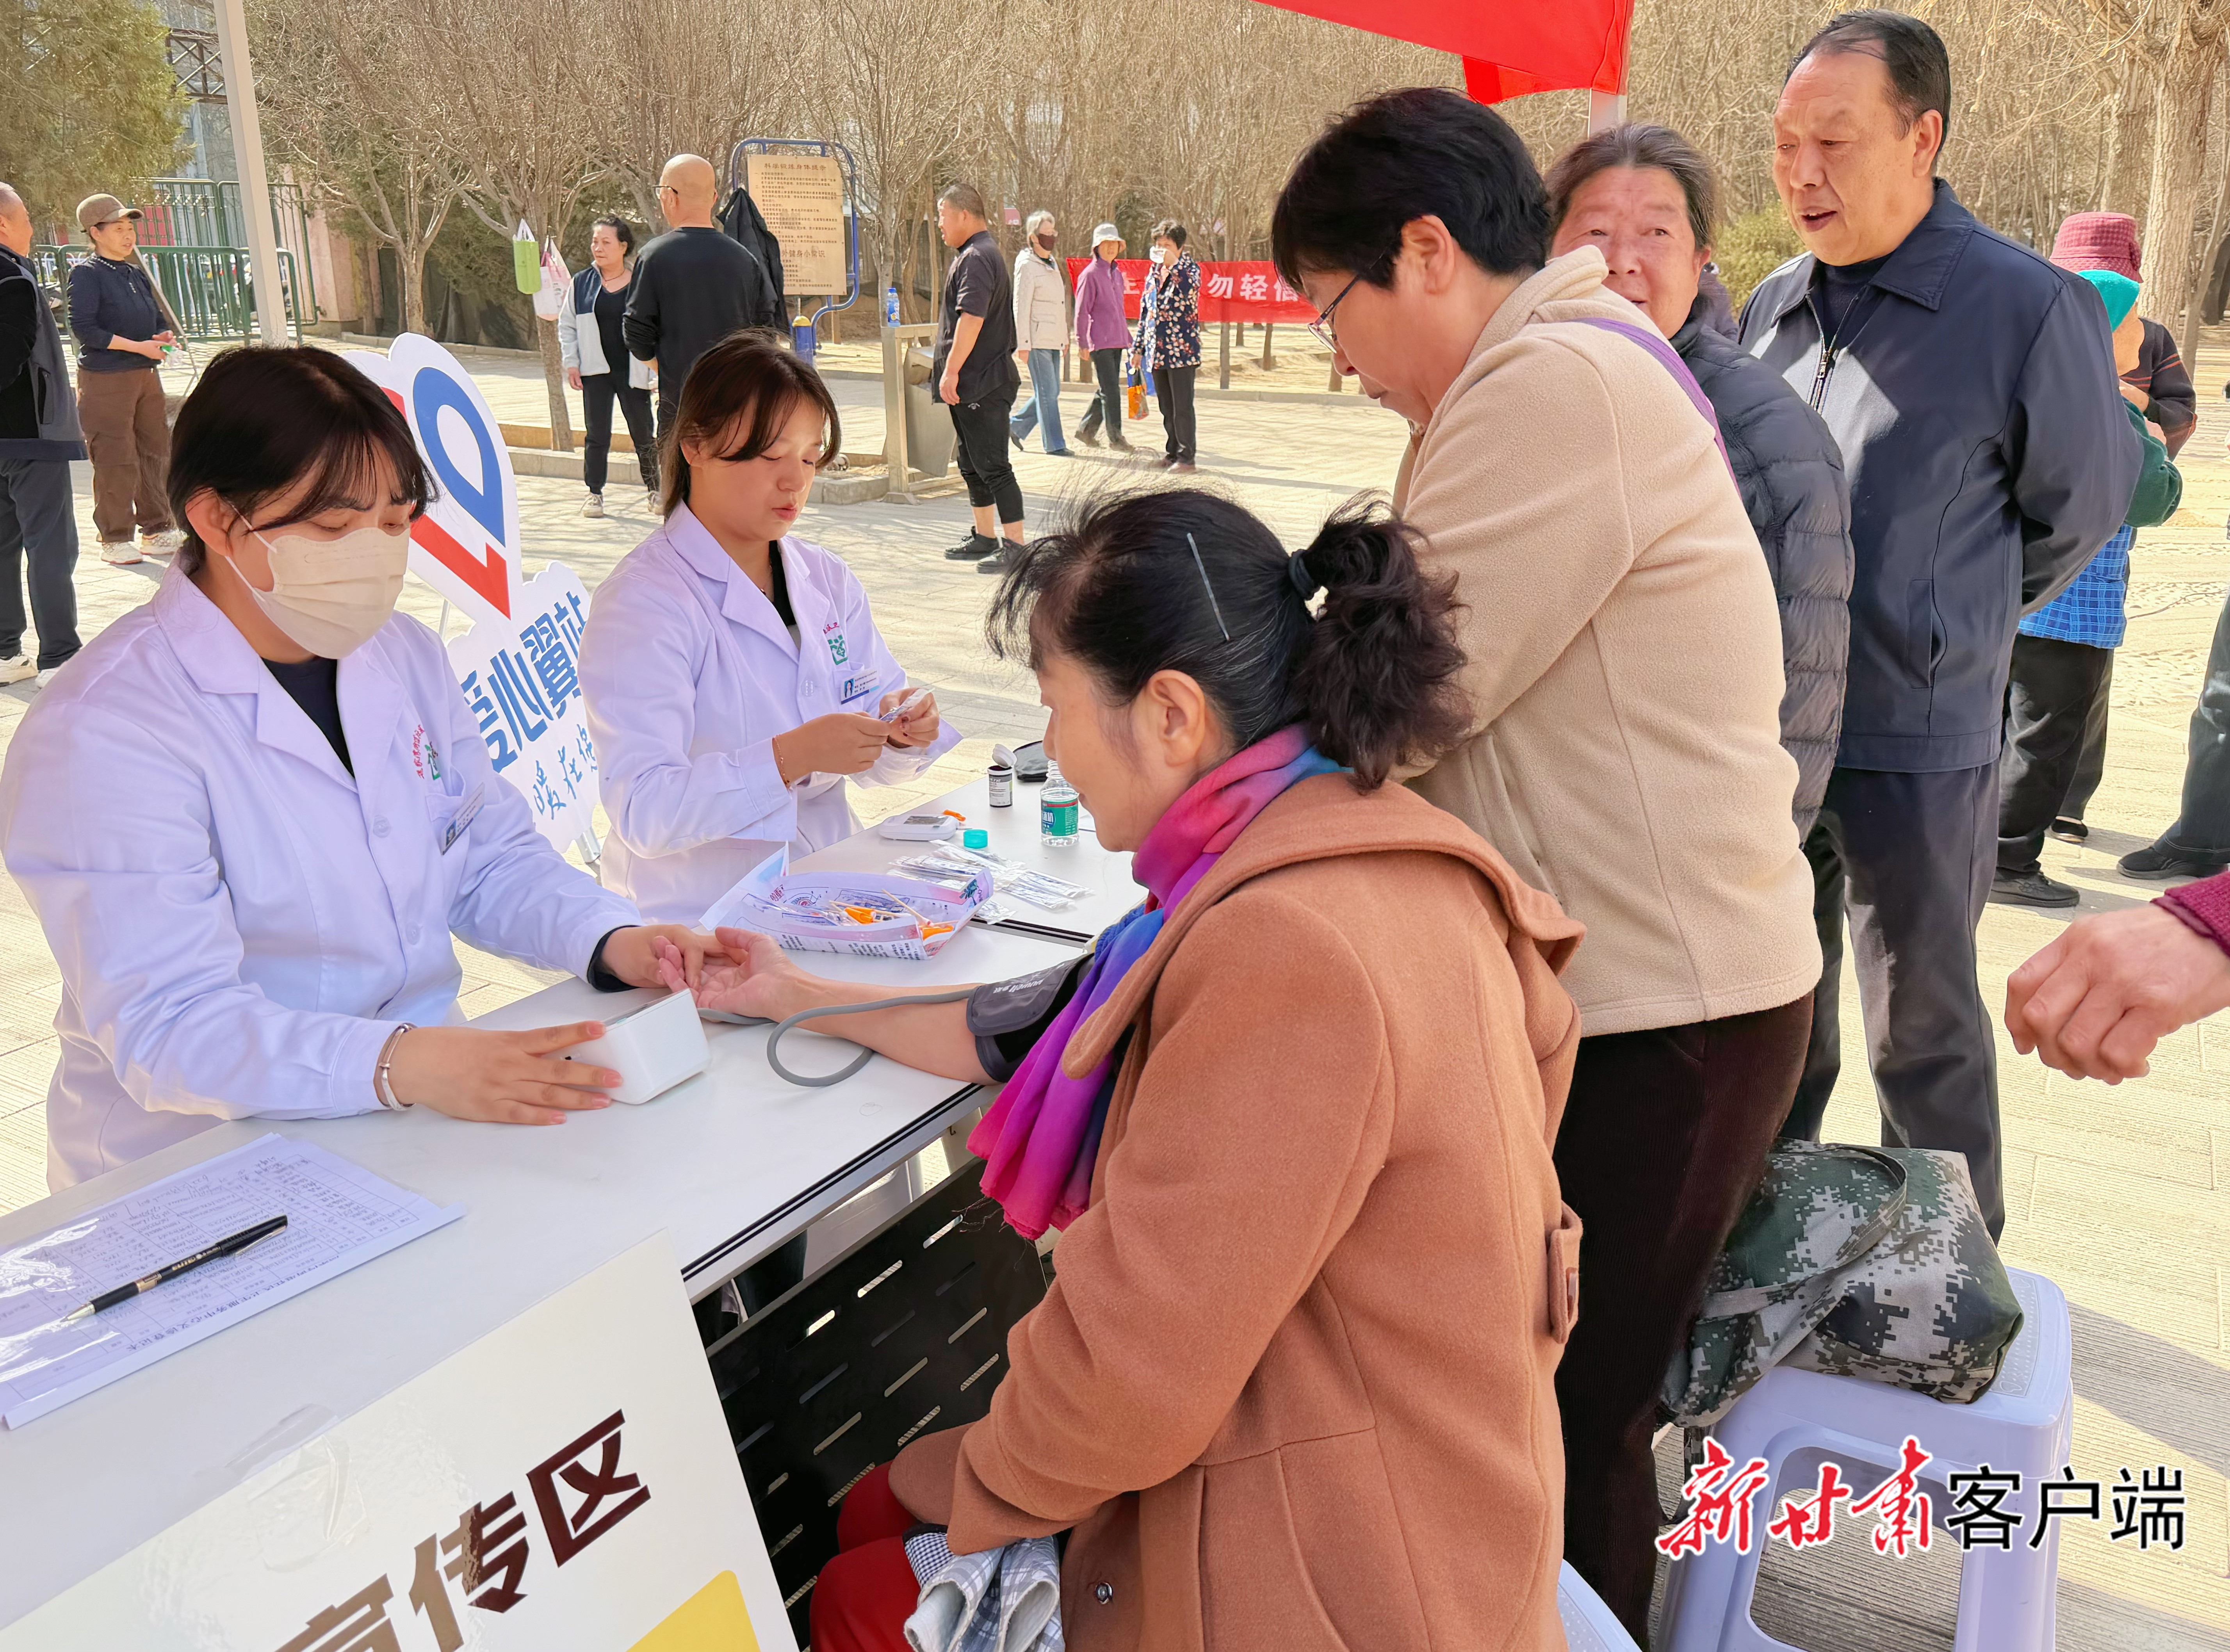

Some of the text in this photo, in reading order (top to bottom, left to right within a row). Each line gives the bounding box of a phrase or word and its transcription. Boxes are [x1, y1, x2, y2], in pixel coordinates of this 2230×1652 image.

[764, 163, 826, 171] 科学锻炼身体提示
